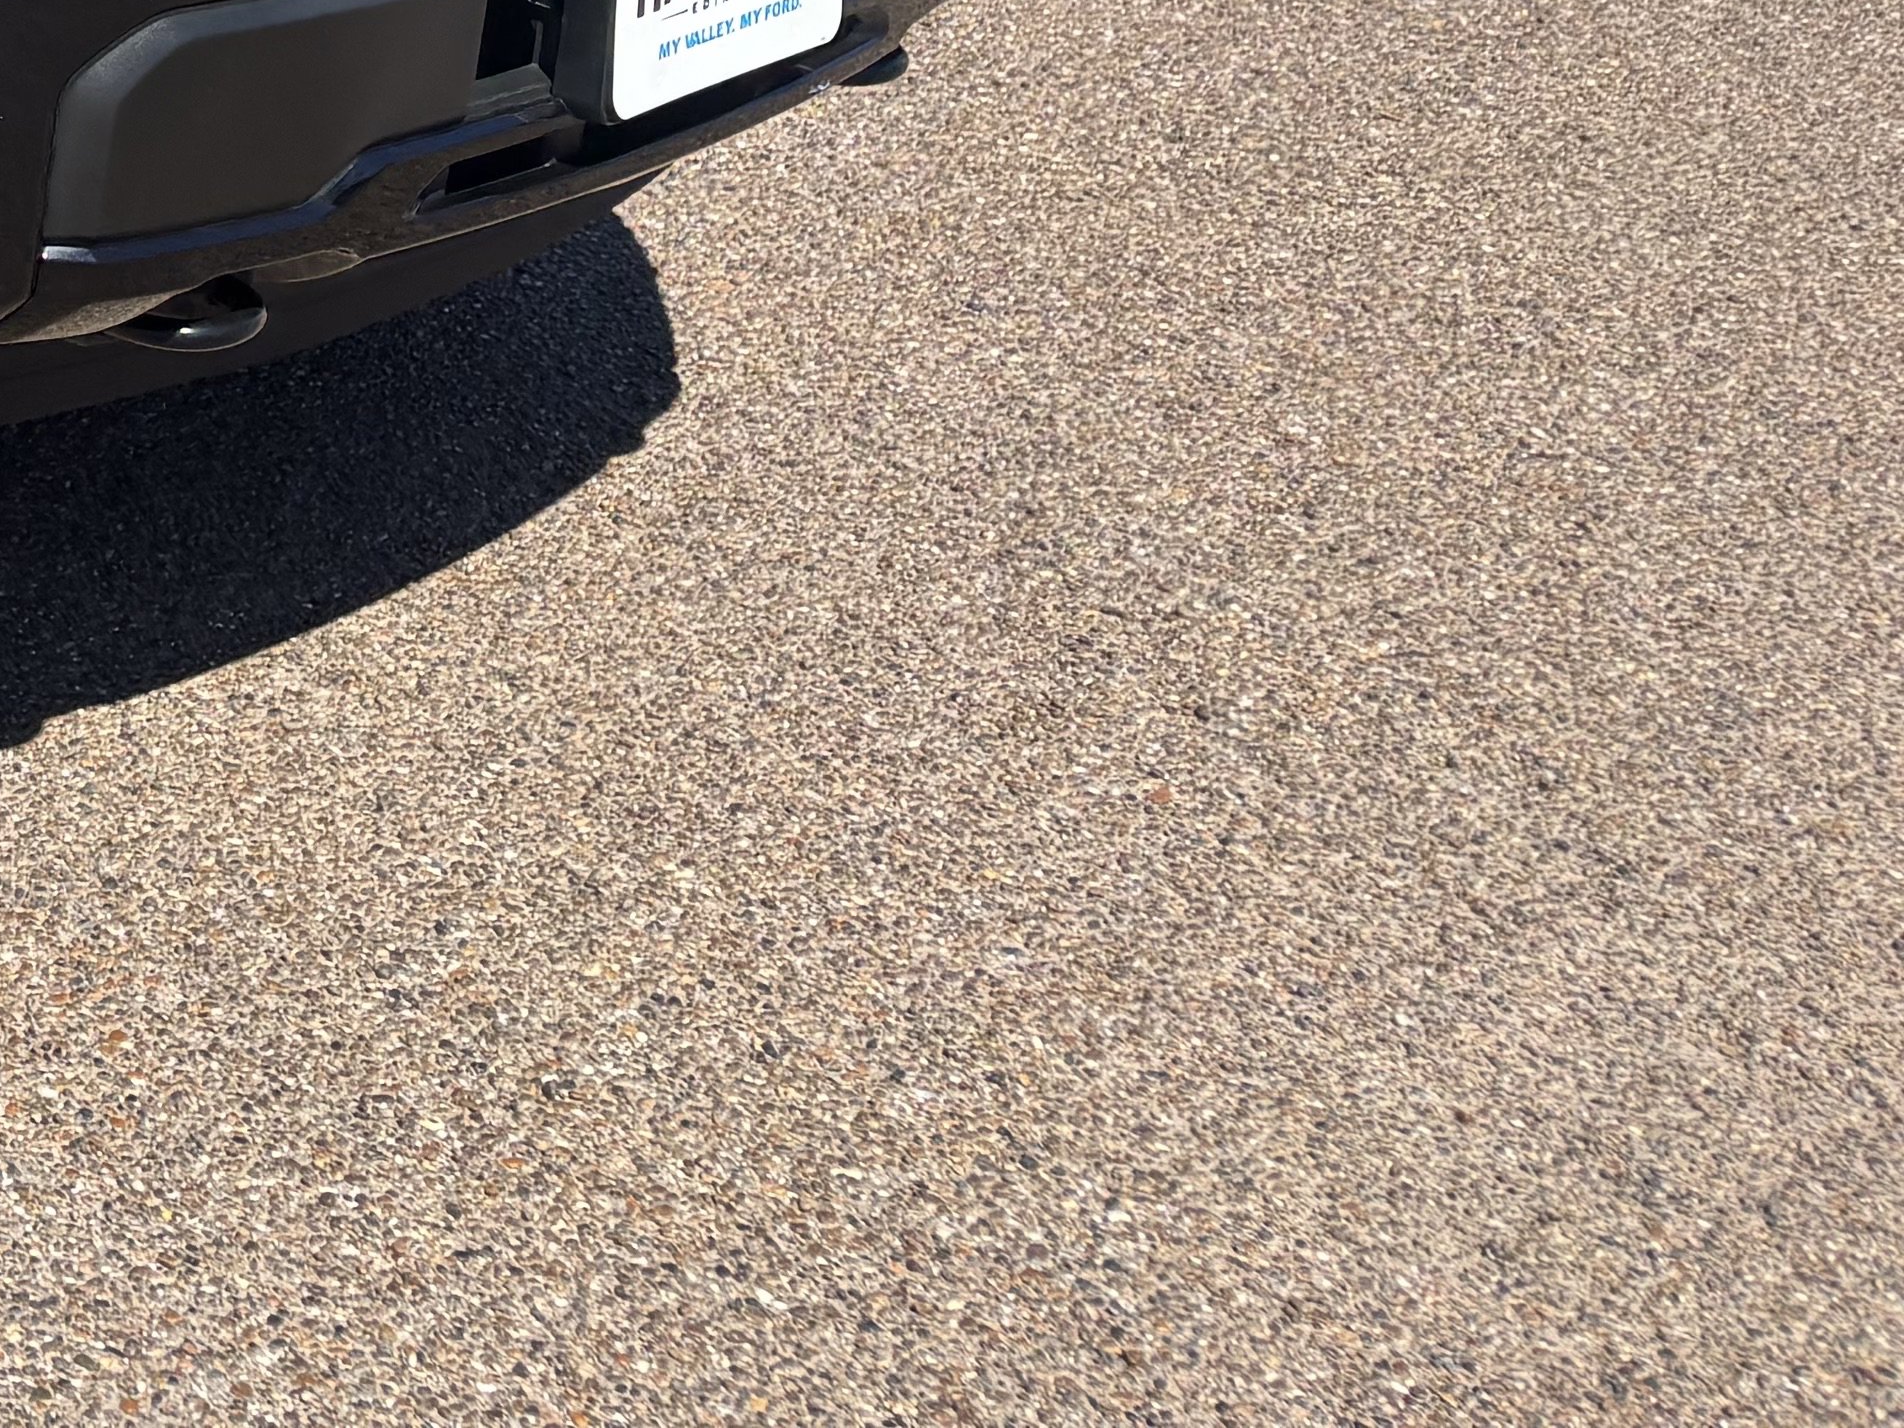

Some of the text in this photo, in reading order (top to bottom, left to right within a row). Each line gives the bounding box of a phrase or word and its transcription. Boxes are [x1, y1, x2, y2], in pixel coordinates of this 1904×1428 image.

[658, 37, 681, 60] MY
[685, 18, 735, 49] VALLEY.
[740, 7, 762, 29] MY
